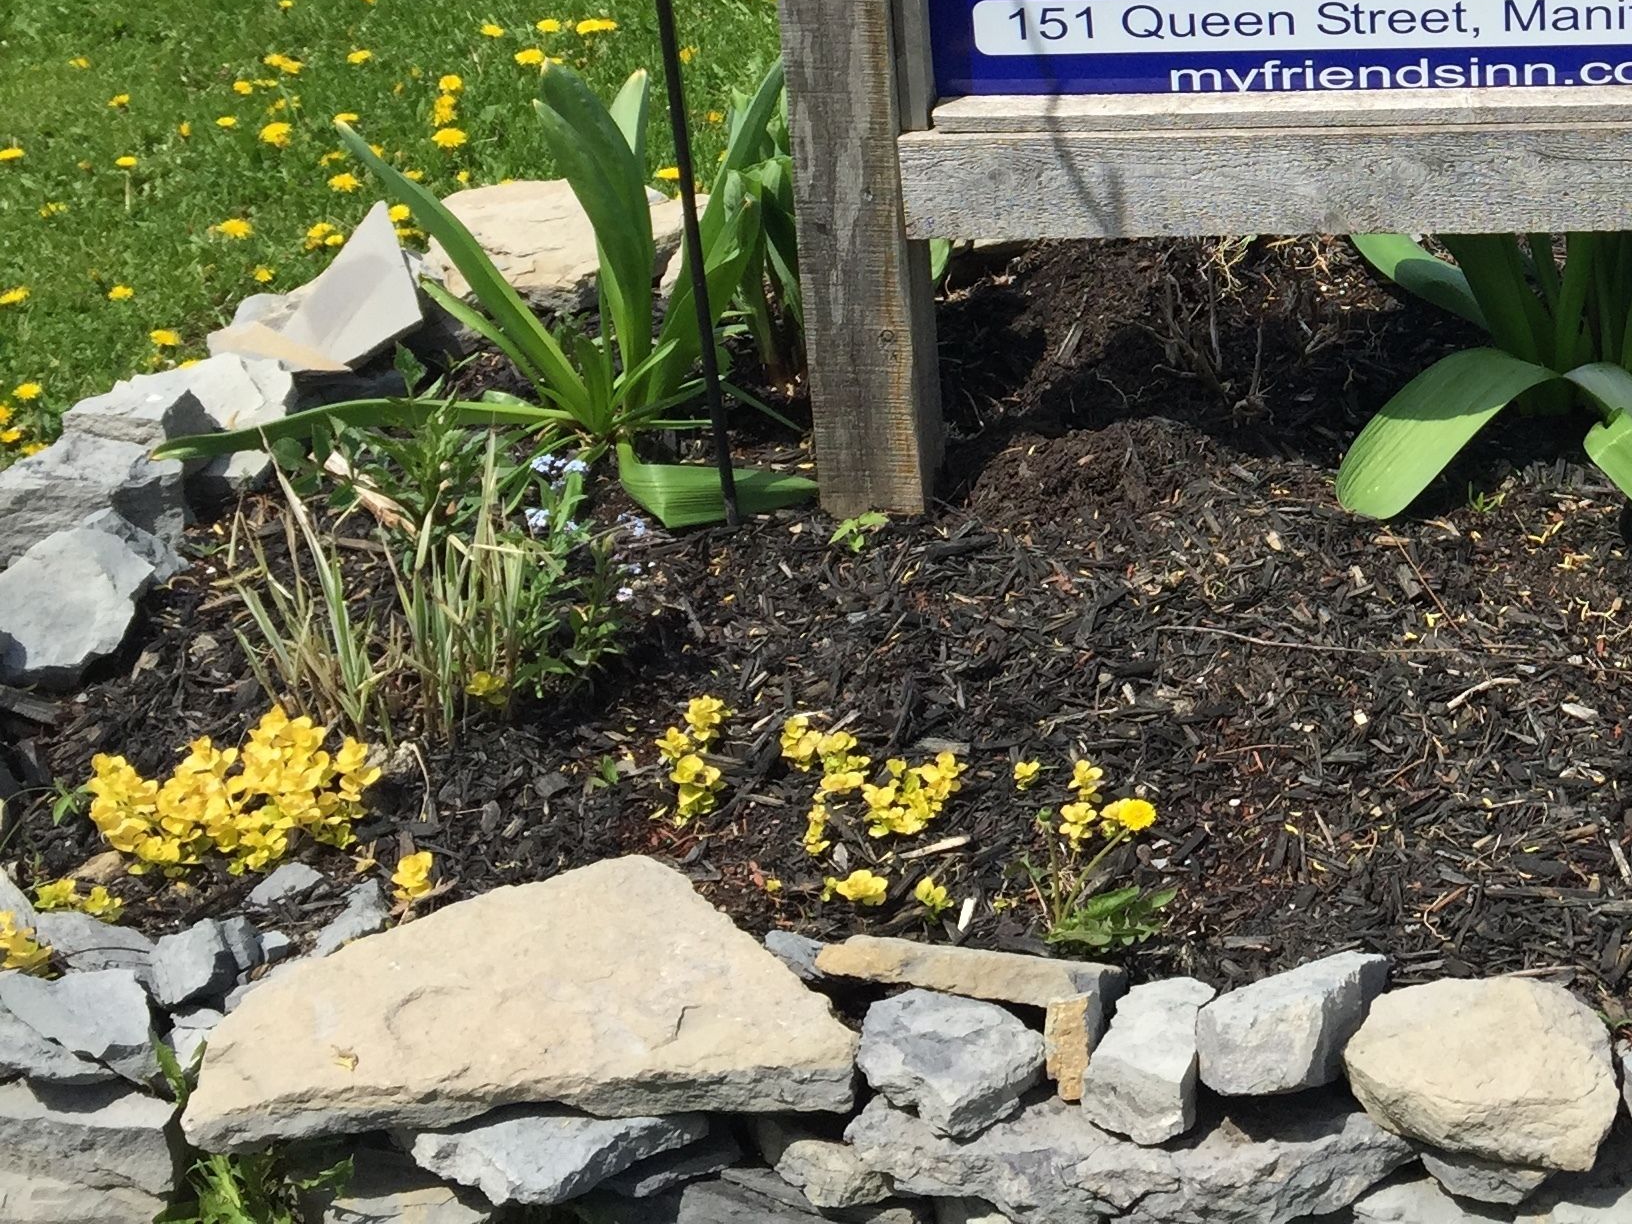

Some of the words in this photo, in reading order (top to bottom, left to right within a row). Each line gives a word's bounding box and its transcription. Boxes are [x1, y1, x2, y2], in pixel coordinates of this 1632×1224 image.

[1008, 6, 1094, 41] 151
[1121, 4, 1295, 40] Queen
[1317, 1, 1480, 39] Street,
